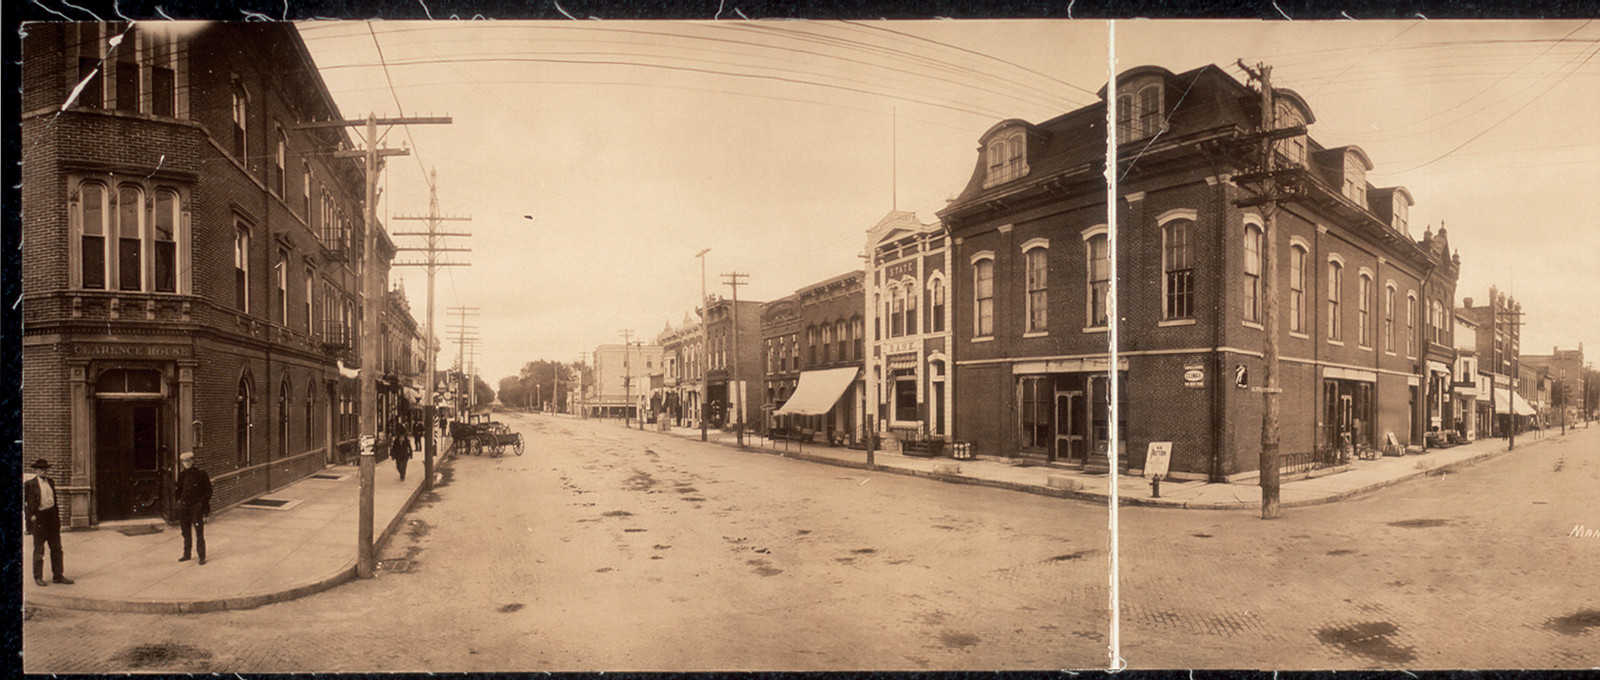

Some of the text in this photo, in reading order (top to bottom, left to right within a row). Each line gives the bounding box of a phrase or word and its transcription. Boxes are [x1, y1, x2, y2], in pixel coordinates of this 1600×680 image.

[889, 262, 913, 277] STATE
[73, 345, 189, 356] CLARENCE HOUSE
